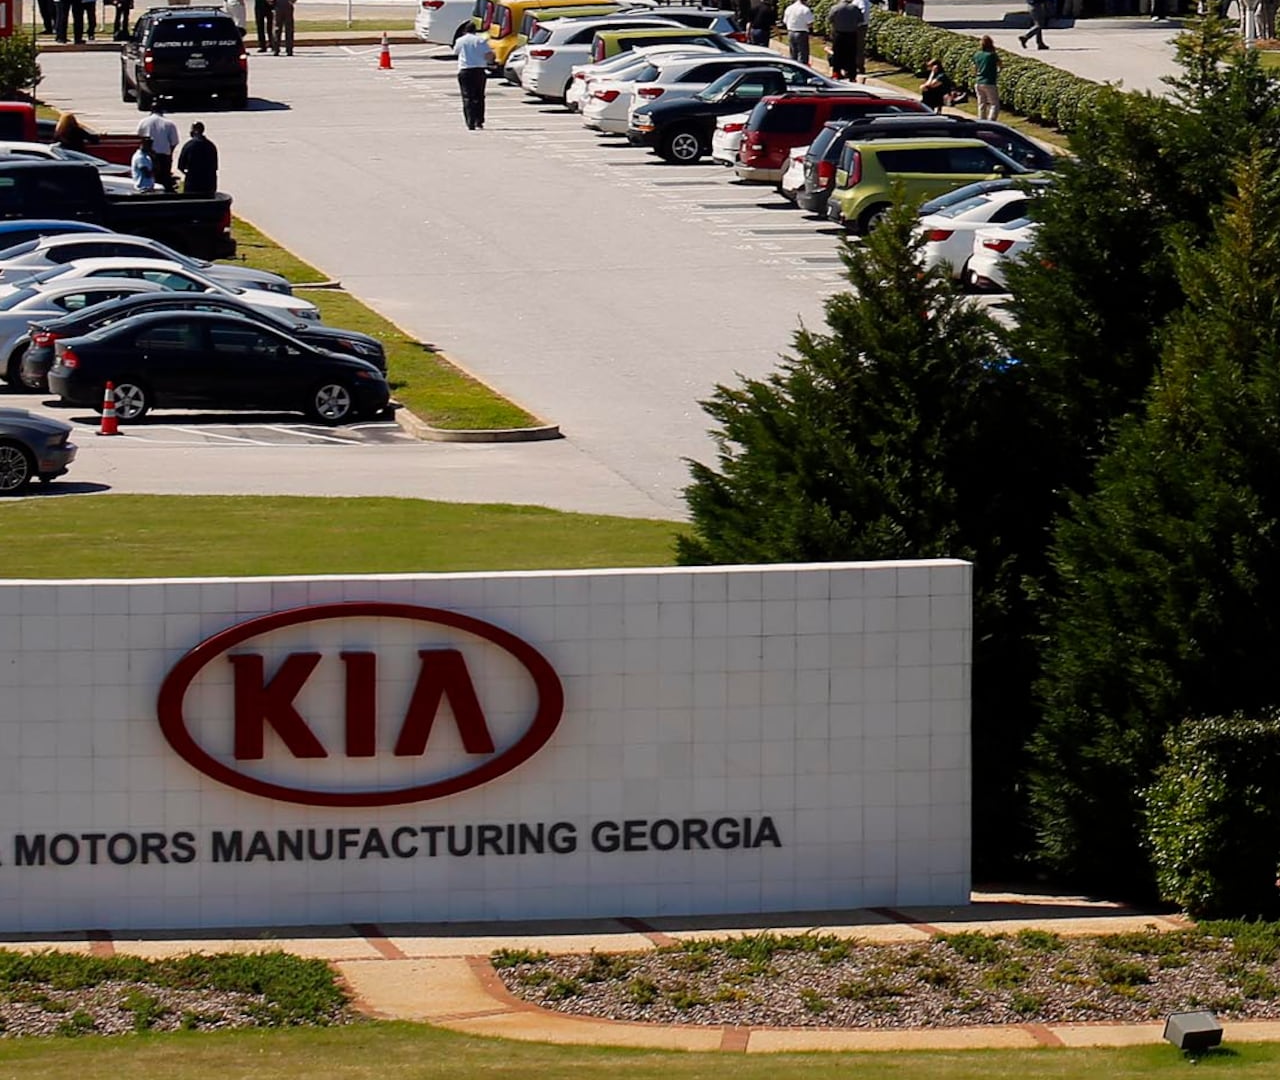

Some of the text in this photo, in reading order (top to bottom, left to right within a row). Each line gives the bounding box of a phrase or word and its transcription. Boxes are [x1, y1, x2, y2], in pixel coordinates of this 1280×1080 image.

[228, 649, 495, 760] KIA
[14, 816, 782, 866] MOTORS MANUFACTURING GEORGIA
